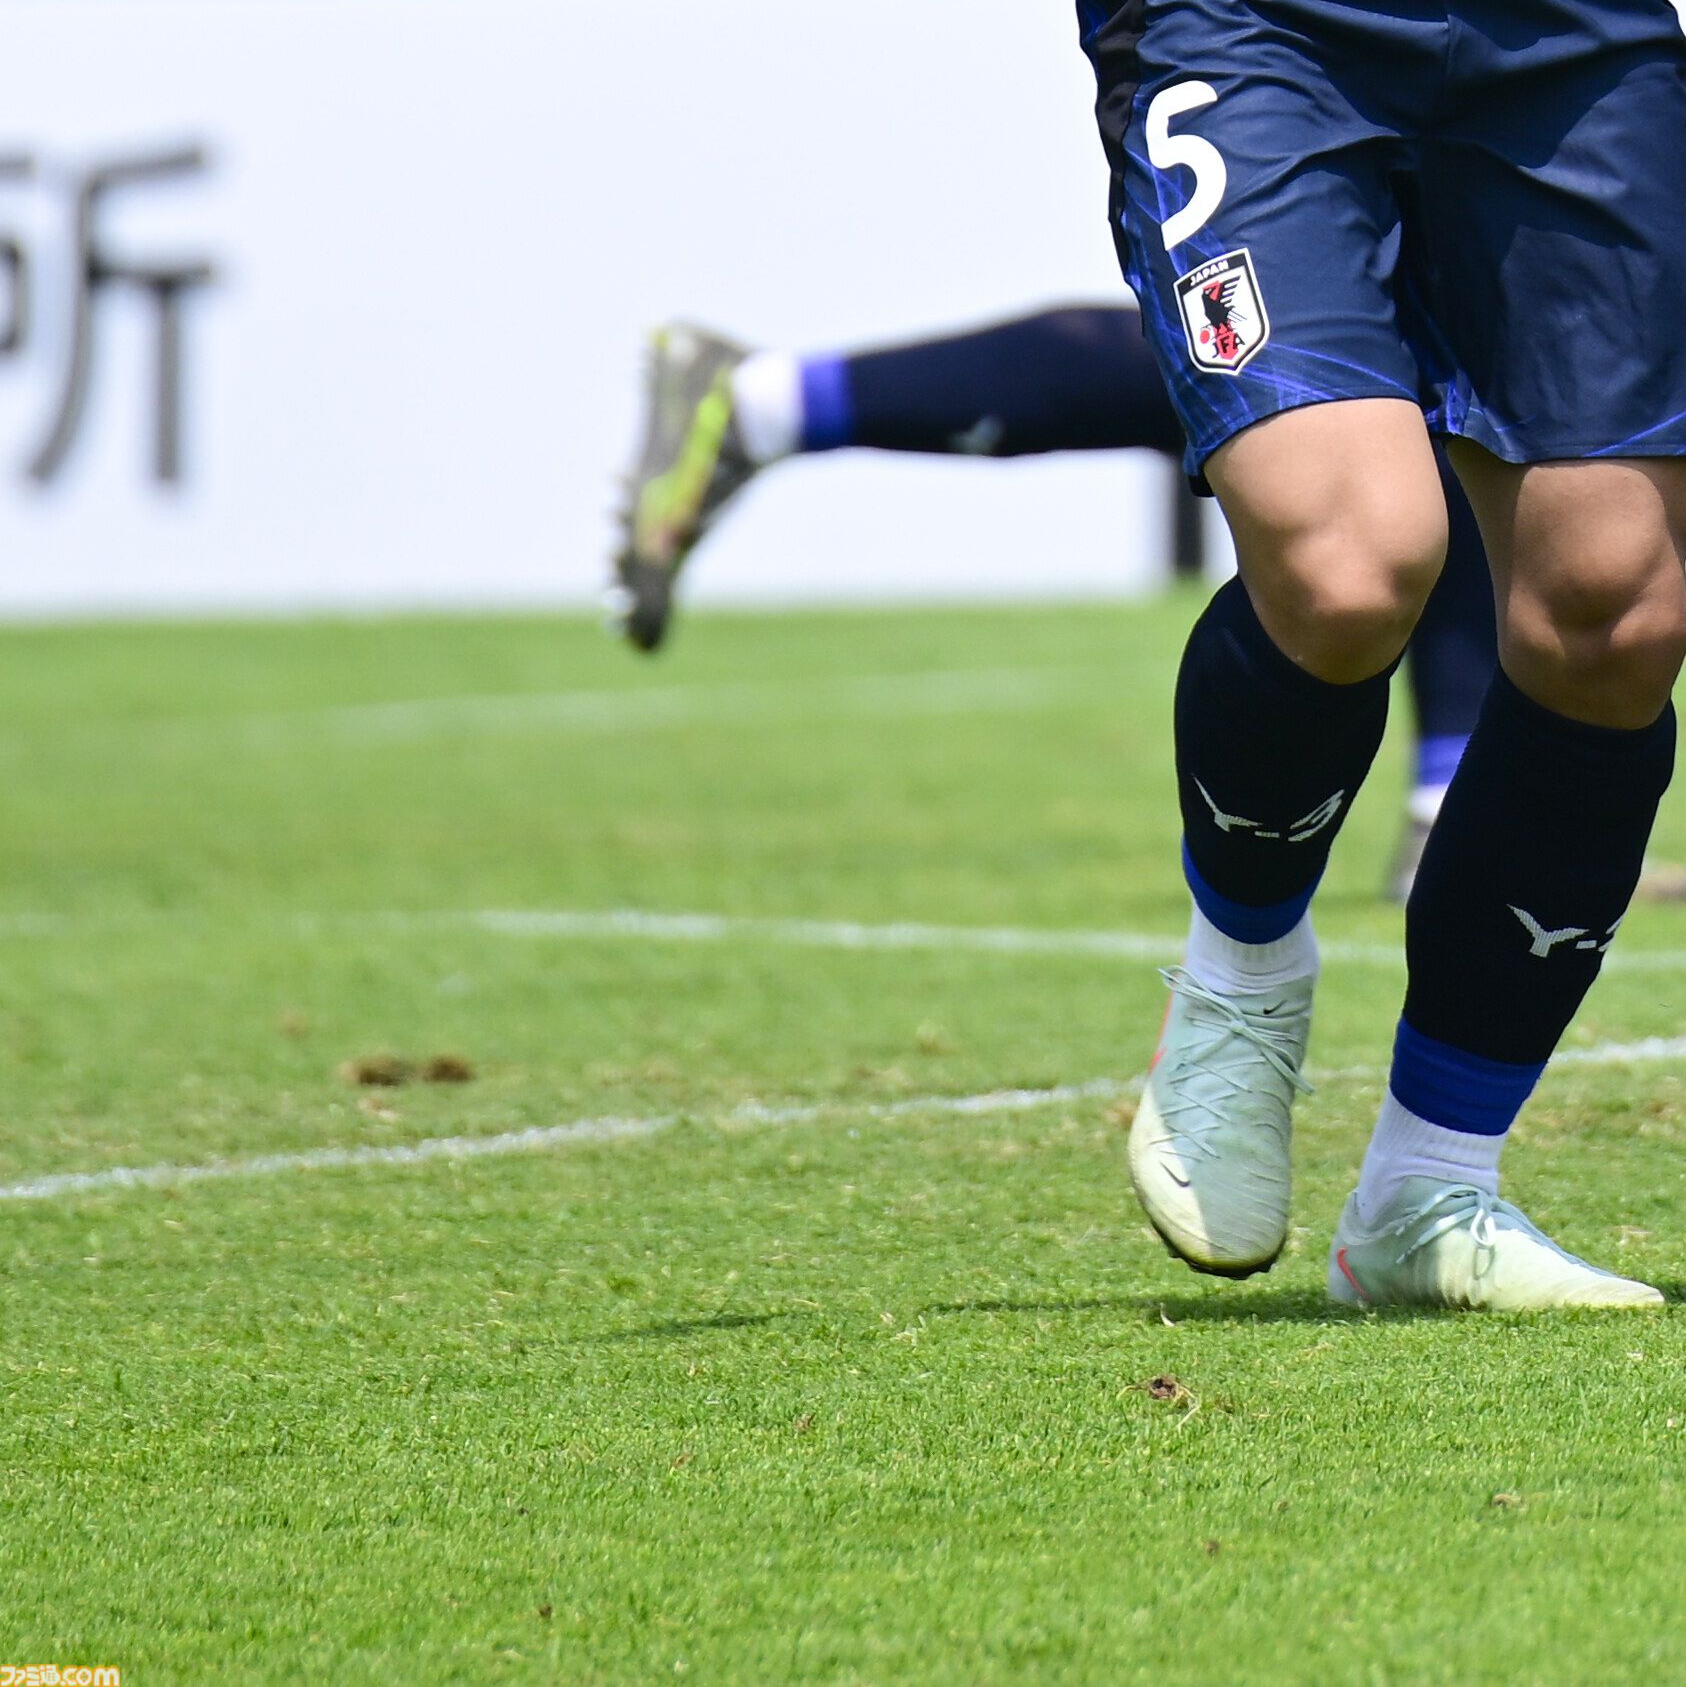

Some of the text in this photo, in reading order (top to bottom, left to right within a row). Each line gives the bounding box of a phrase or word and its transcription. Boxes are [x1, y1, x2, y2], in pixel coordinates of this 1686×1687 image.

[1145, 80, 1228, 251] 5
[1190, 259, 1230, 287] JAPAN
[1211, 332, 1246, 359] JFA
[1192, 775, 1345, 842] Y-3
[1506, 903, 1624, 958] Y-
